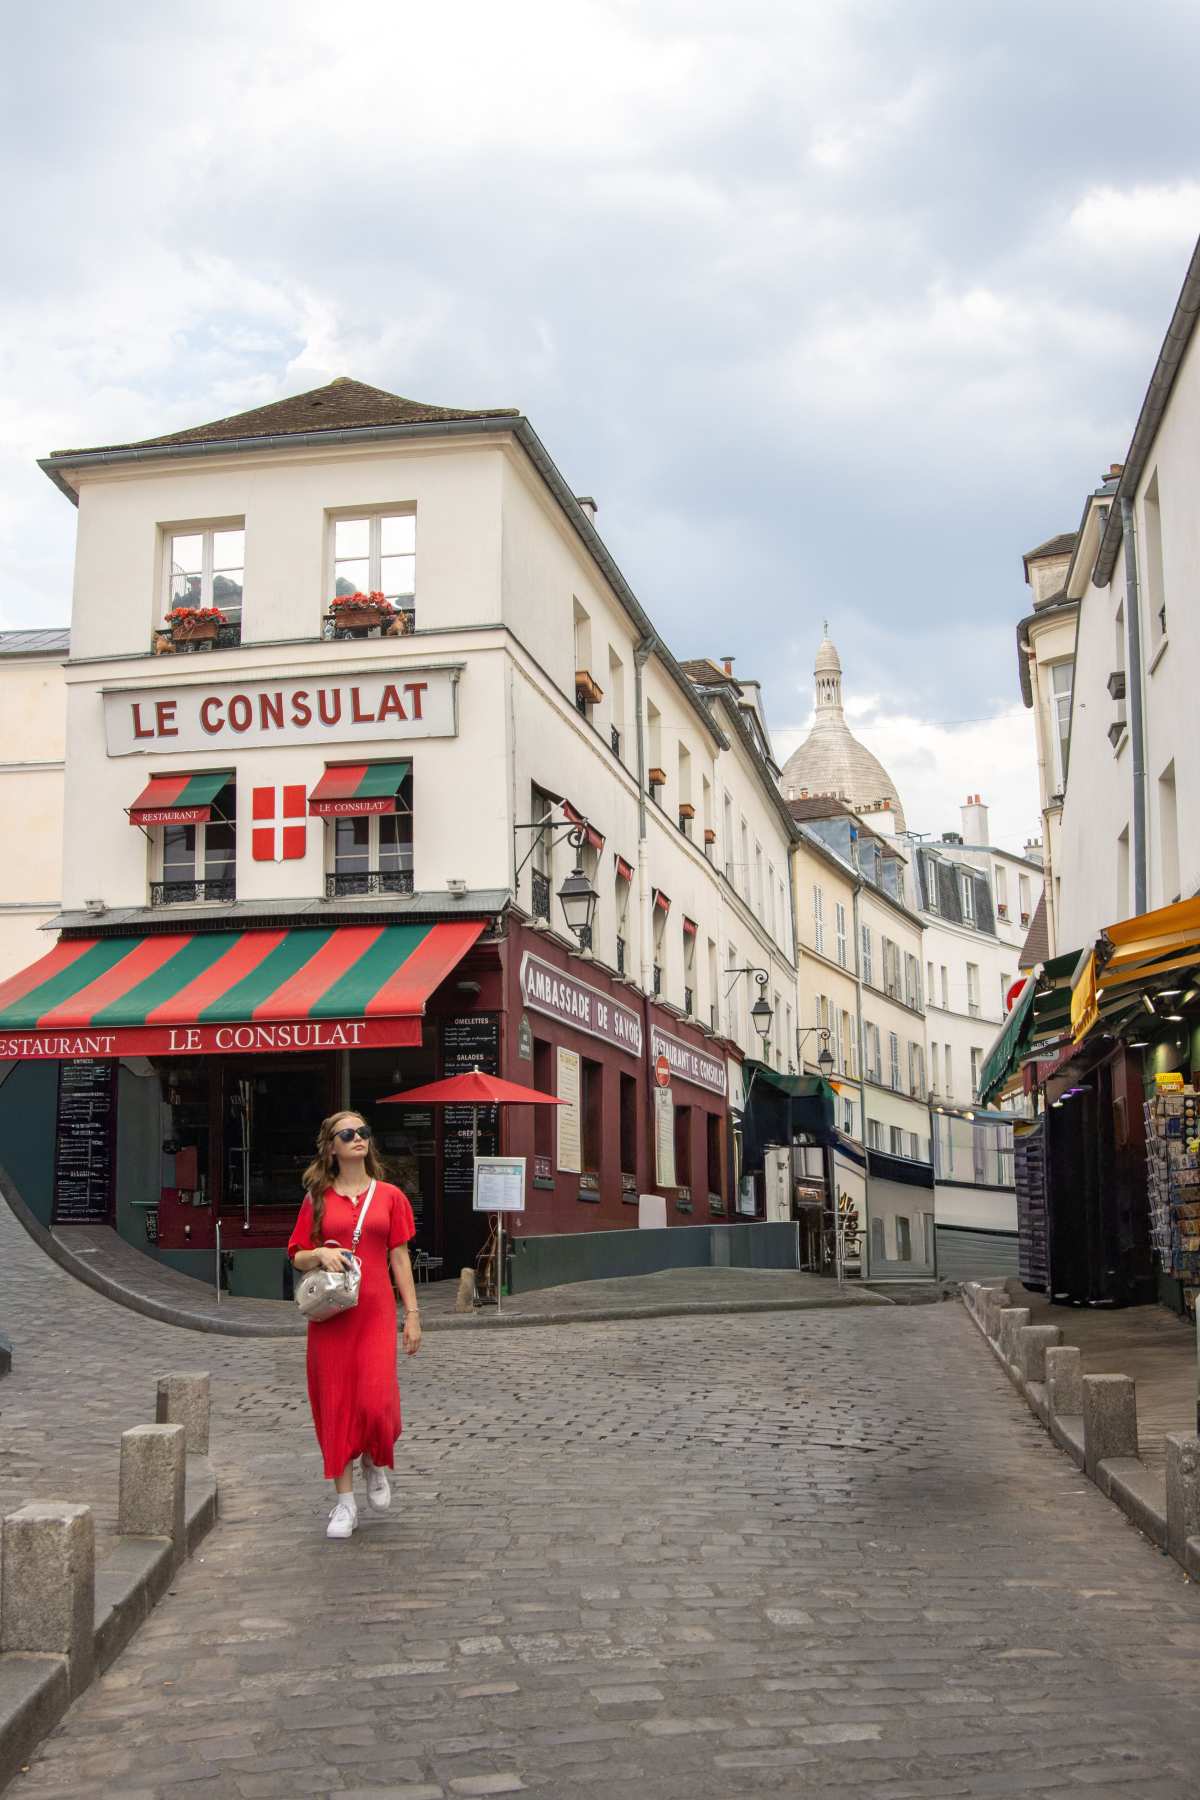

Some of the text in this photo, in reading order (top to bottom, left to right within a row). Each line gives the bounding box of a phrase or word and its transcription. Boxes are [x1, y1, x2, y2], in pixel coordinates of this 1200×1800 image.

[131, 682, 429, 740] LE CONSULAT
[319, 801, 385, 812] LE CONSULAT
[142, 810, 199, 821] RESTAURANT
[527, 967, 640, 1047] AMBASSADE DE SAVOIE
[454, 1017, 489, 1025] OMELETTES
[168, 1023, 366, 1051] LE CONSULAT
[457, 1129, 482, 1138] CRÊPS
